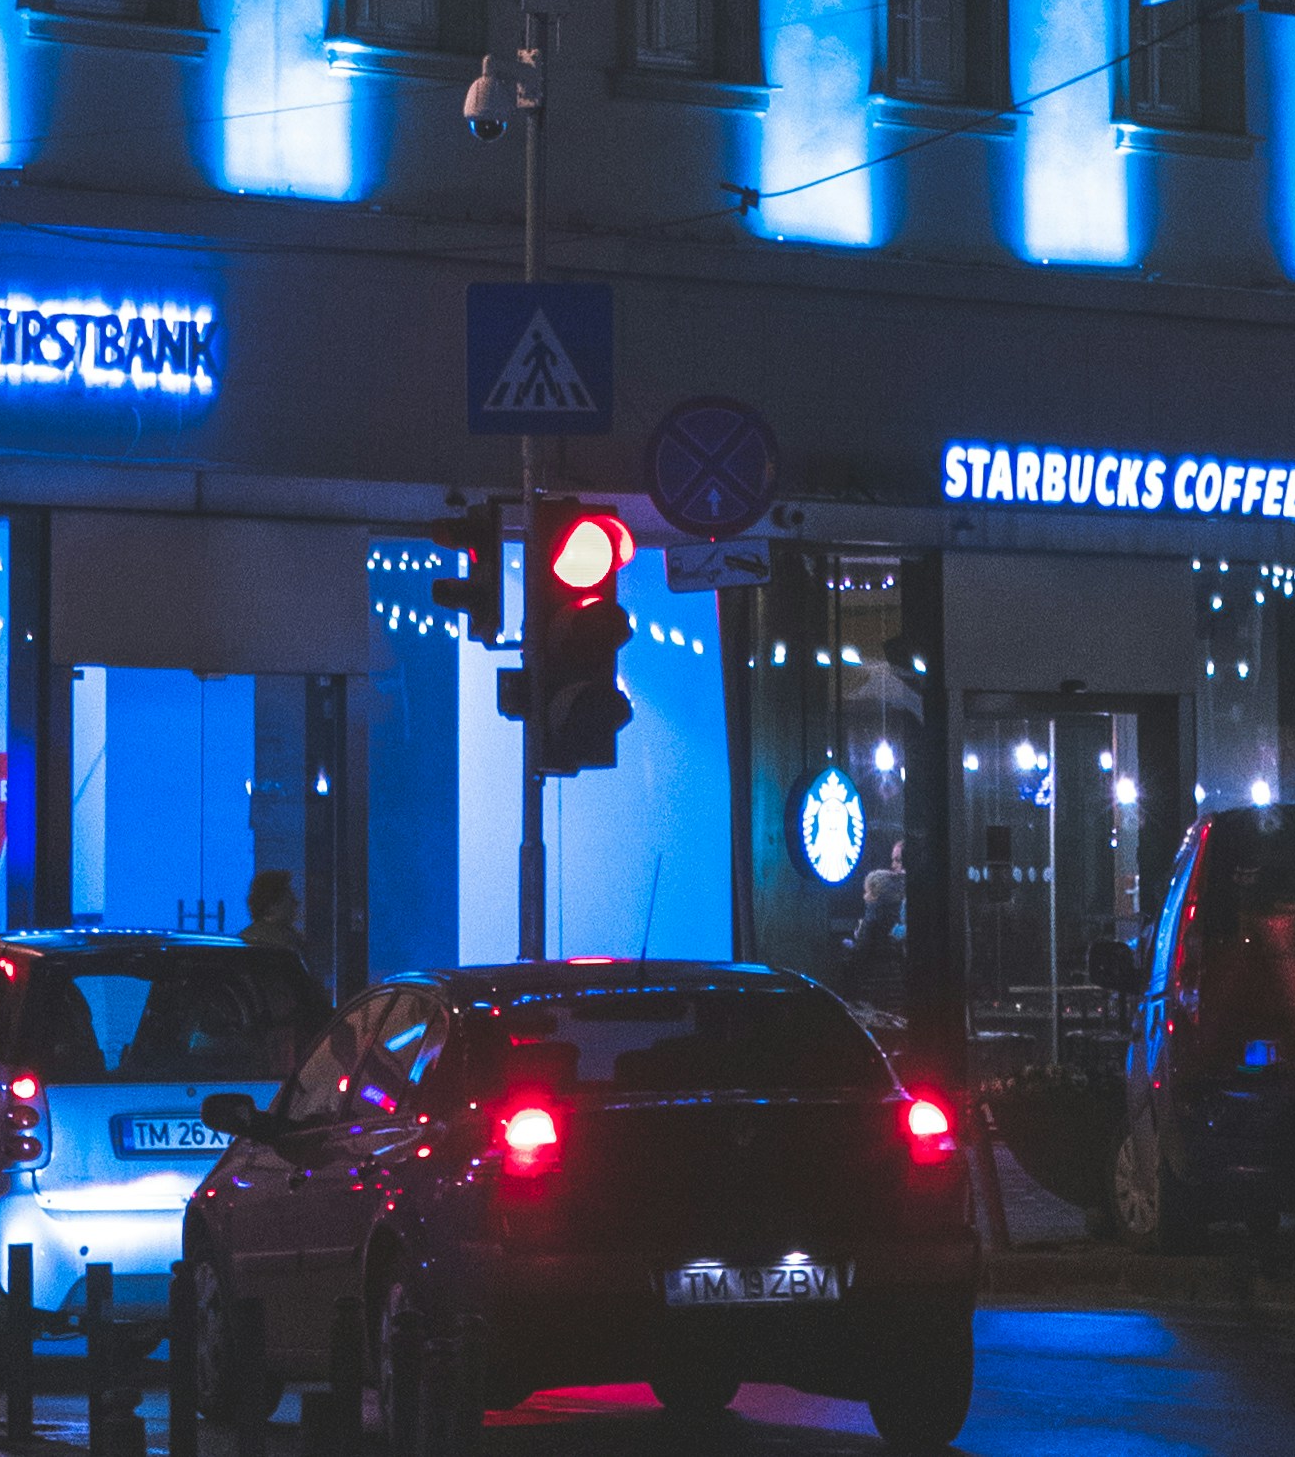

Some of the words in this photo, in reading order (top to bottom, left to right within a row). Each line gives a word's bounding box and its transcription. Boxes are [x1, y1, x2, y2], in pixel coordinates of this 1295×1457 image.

[944, 445, 1167, 510] STARBUCKS
[134, 1122, 170, 1146] TM
[178, 1122, 205, 1146] 26
[684, 1271, 727, 1299] TM
[767, 1267, 831, 1299] ZBV
